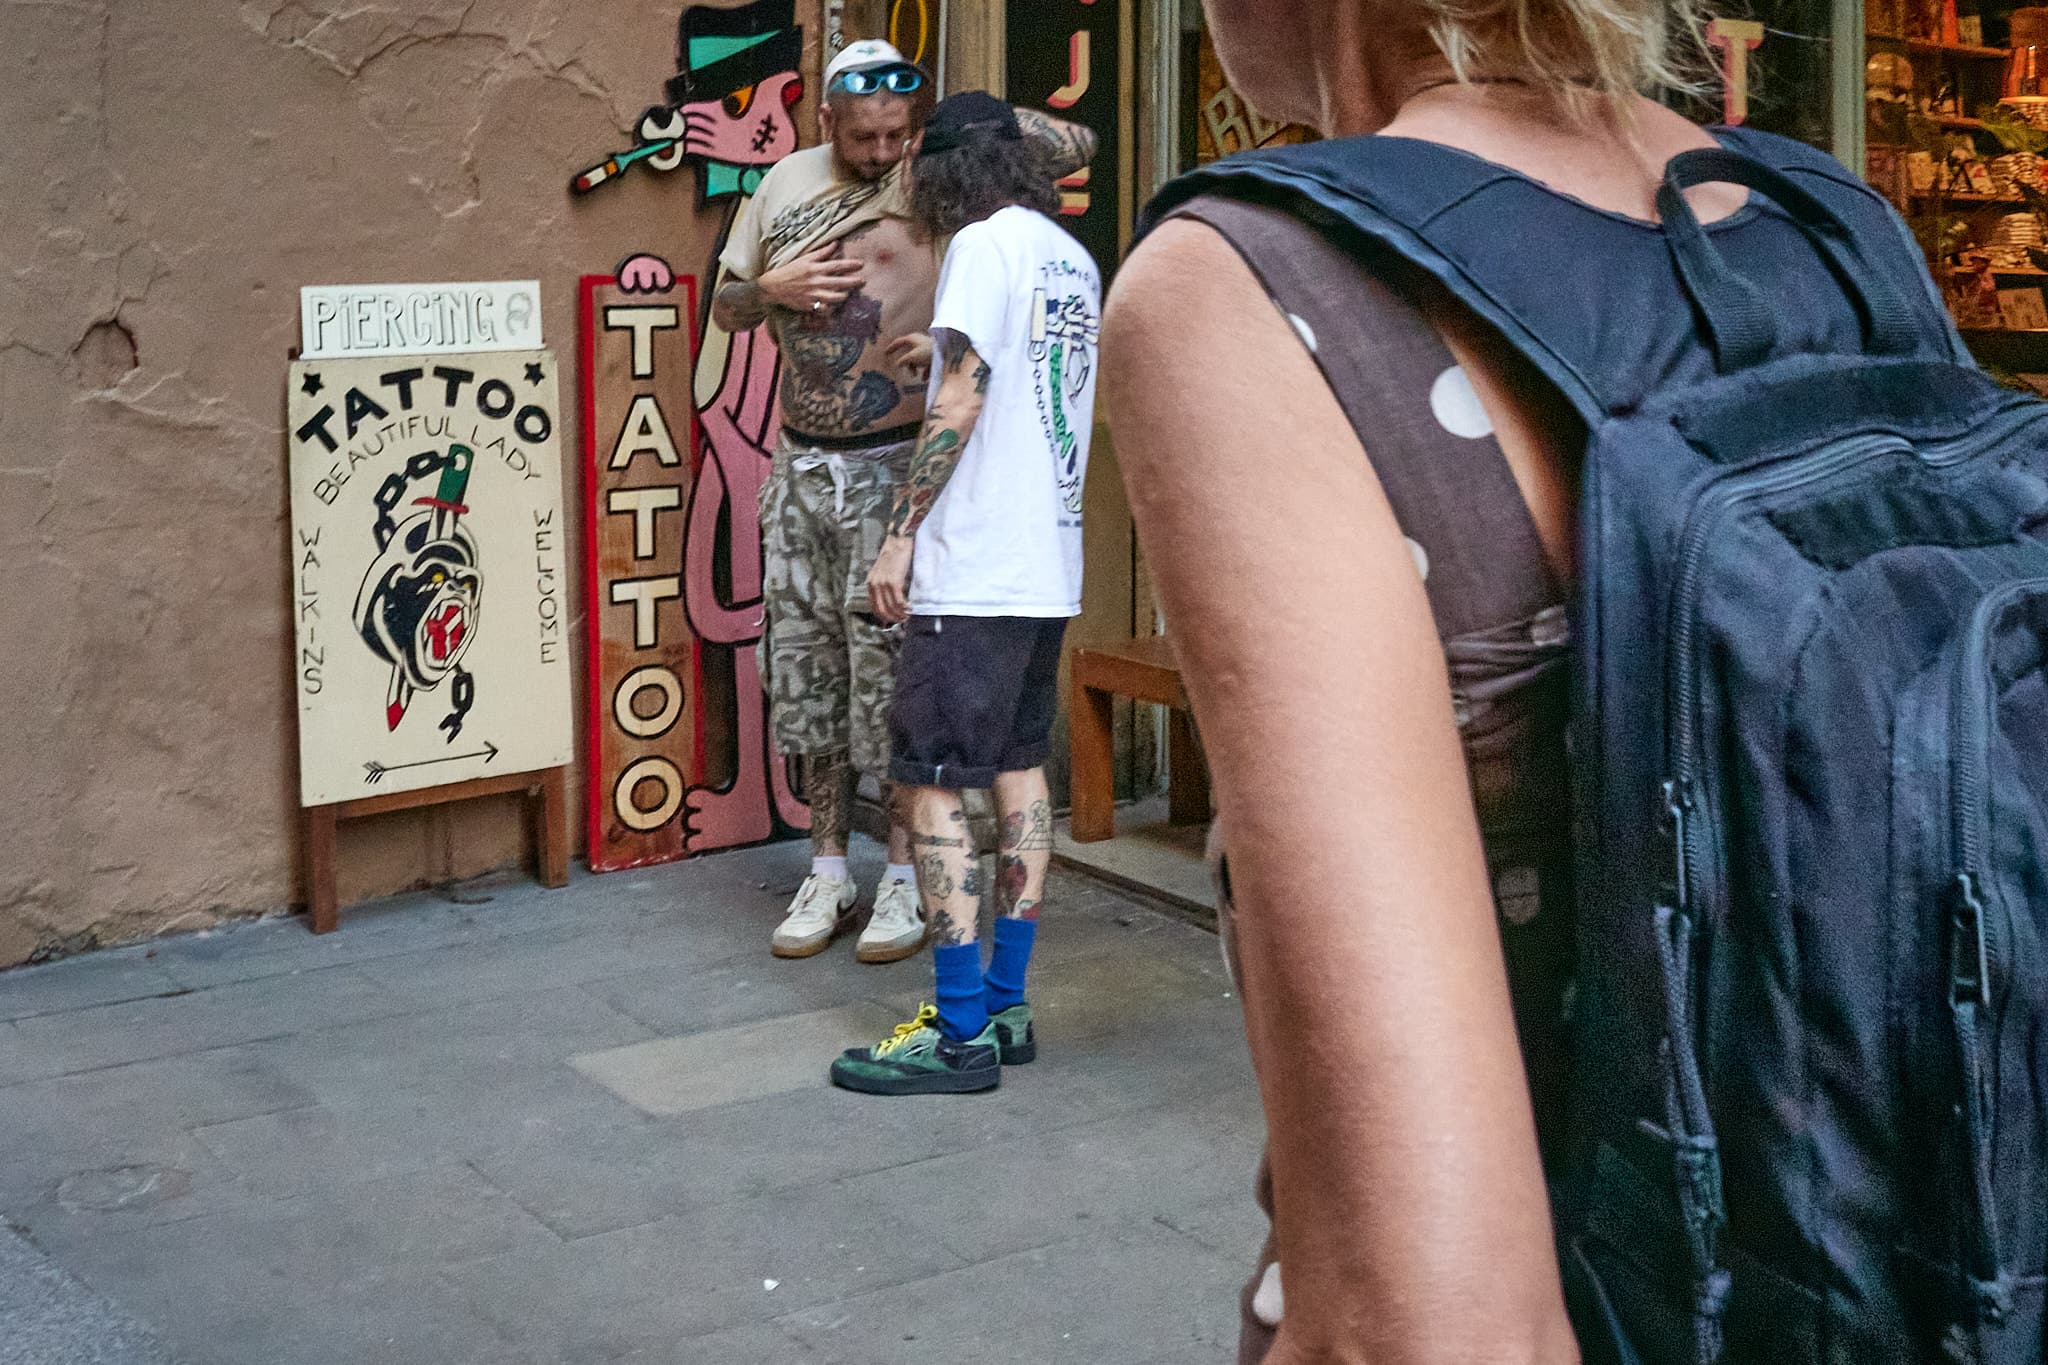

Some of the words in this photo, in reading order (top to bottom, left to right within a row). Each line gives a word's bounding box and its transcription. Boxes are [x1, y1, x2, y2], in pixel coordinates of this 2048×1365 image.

[296, 366, 551, 454] TATTOO
[313, 415, 457, 506] BEAUTIFUL
[470, 424, 541, 481] LADY
[299, 526, 325, 695] WALKINS
[533, 508, 560, 665] WELCOME
[603, 304, 685, 833] TATTOO
